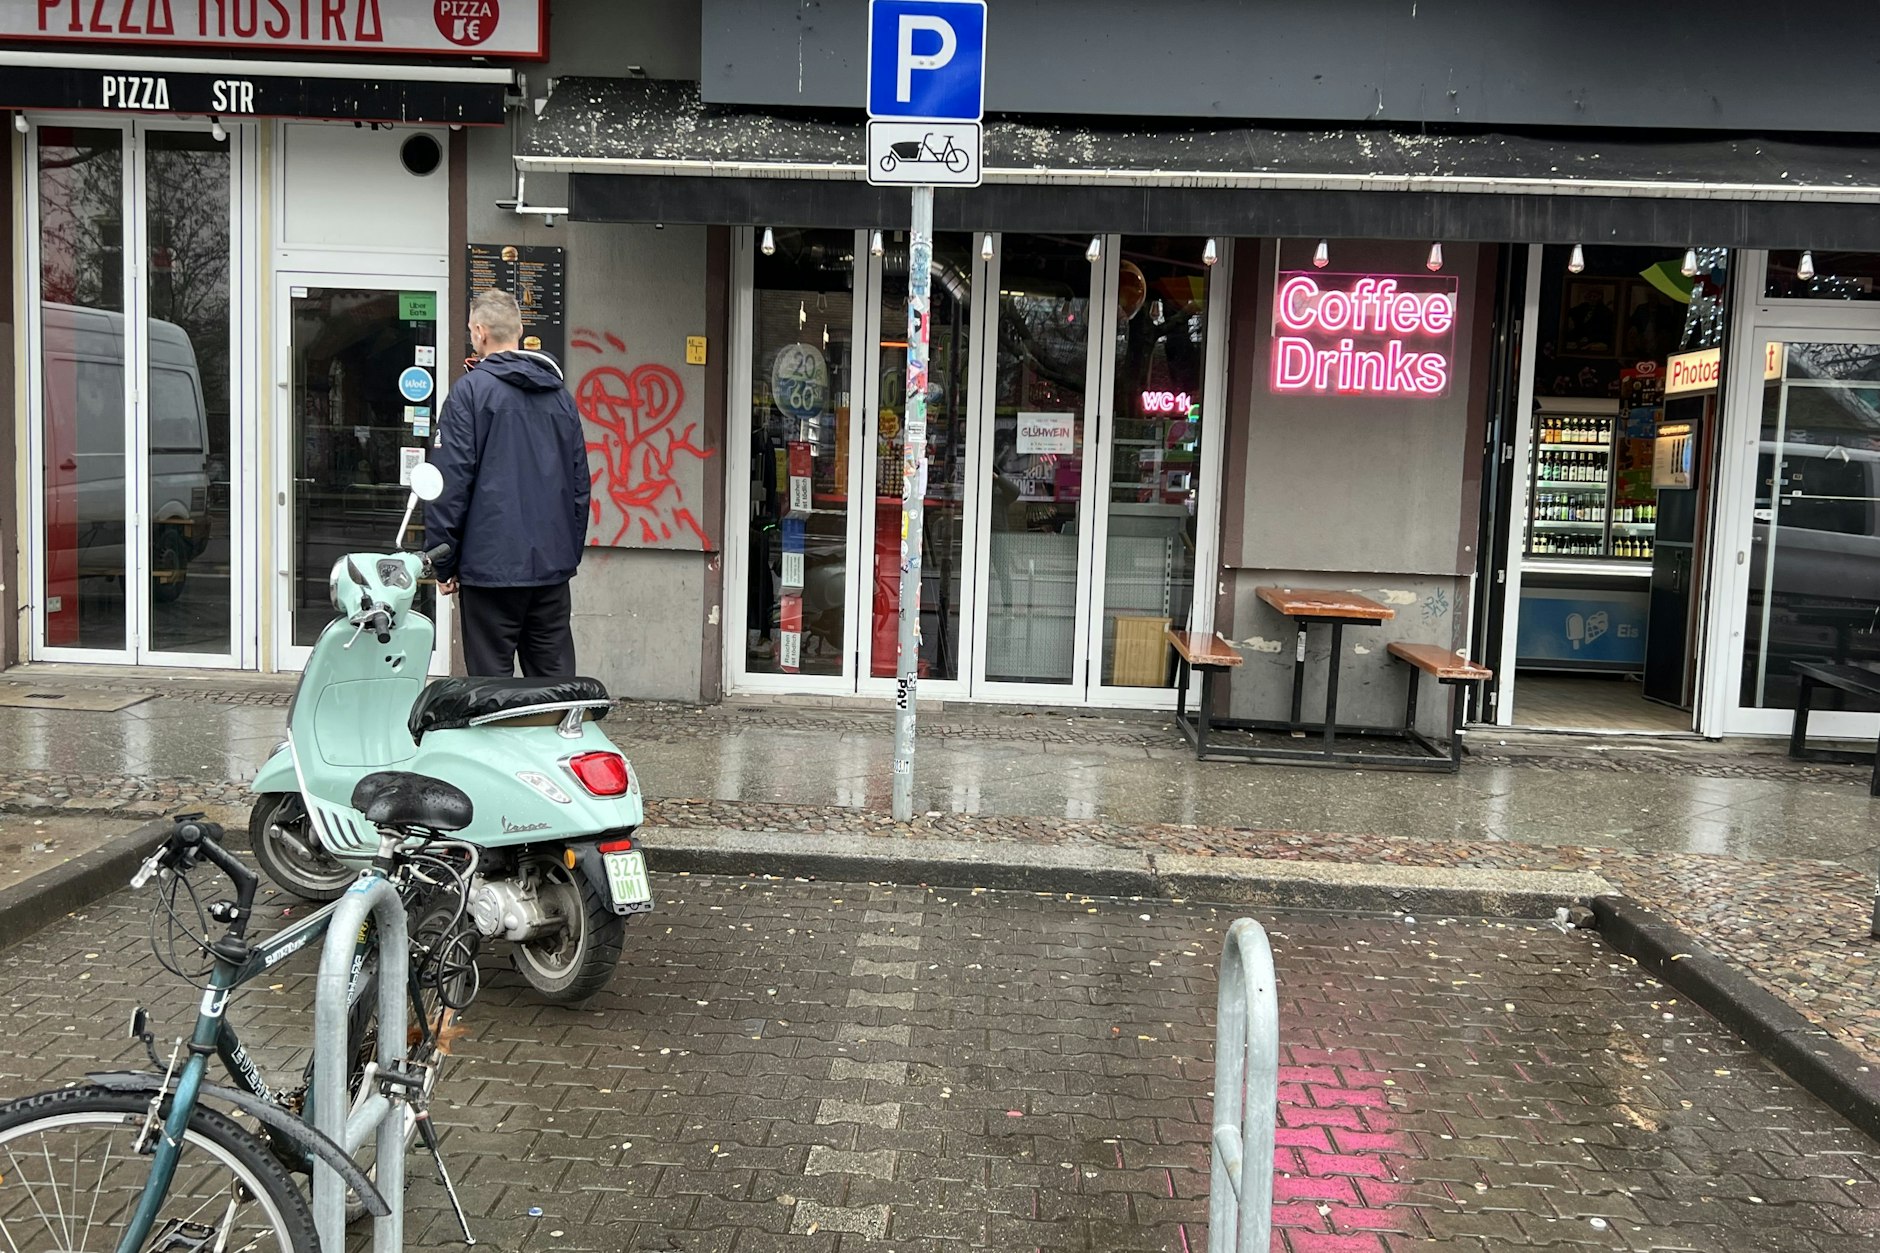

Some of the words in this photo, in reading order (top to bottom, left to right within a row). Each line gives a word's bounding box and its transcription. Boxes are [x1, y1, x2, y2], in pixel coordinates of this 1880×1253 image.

[38, 0, 174, 35] PIZZA
[440, 0, 492, 17] PIZZA
[896, 14, 957, 103] P
[102, 75, 169, 110] PIZZA
[212, 79, 254, 113] STR
[1280, 276, 1453, 333] Coffee
[791, 351, 816, 379] 20
[1276, 336, 1446, 393] Drinks
[404, 379, 427, 389] Wolt
[790, 383, 814, 411] 60
[1142, 390, 1175, 411] WC
[1021, 425, 1070, 438] GLÜHWEIN
[1616, 624, 1639, 638] Eis
[897, 678, 908, 709] PAY
[501, 815, 552, 834] Vespa
[610, 857, 641, 877] 322
